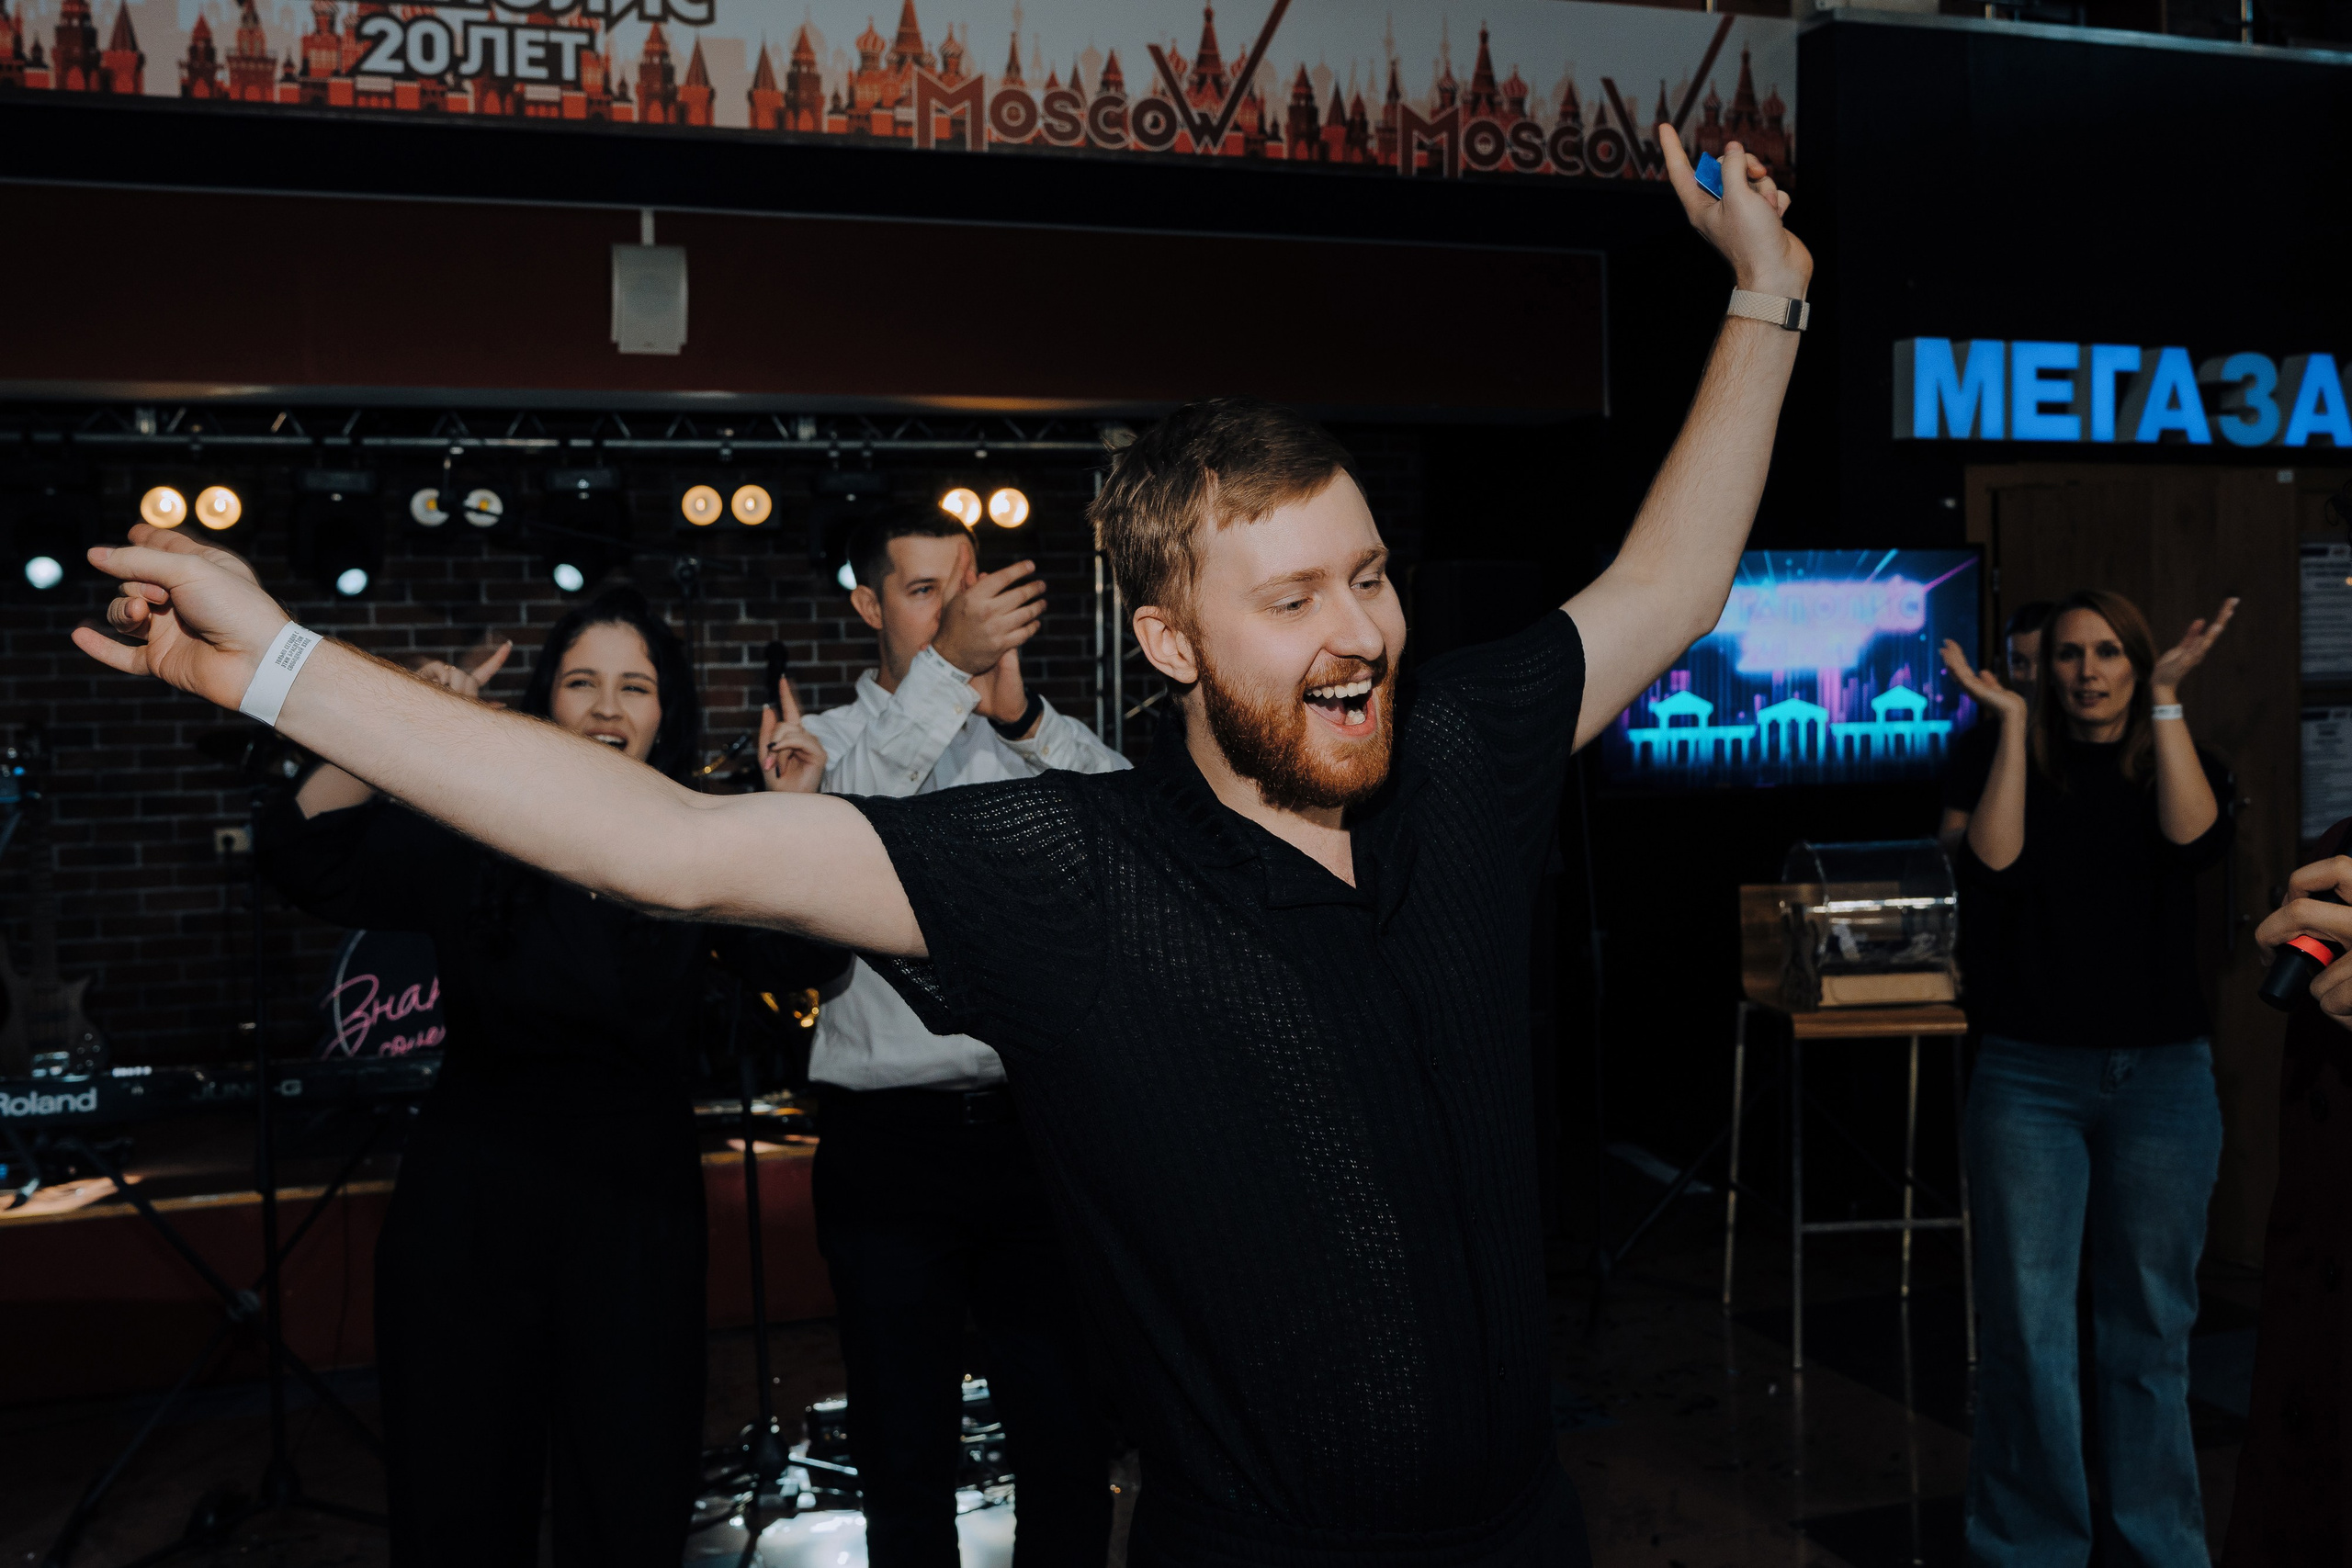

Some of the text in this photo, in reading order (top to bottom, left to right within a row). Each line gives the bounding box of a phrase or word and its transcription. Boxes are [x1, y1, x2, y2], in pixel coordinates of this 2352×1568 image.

[358, 16, 591, 82] 20 ЛЕТ
[275, 649, 288, 665] ТОЛЬКО
[281, 635, 304, 669] ЭТИМ БРАСЛЕТОМ
[287, 647, 304, 671] СВОБОДНЫЙ
[302, 637, 312, 649] ВХОД
